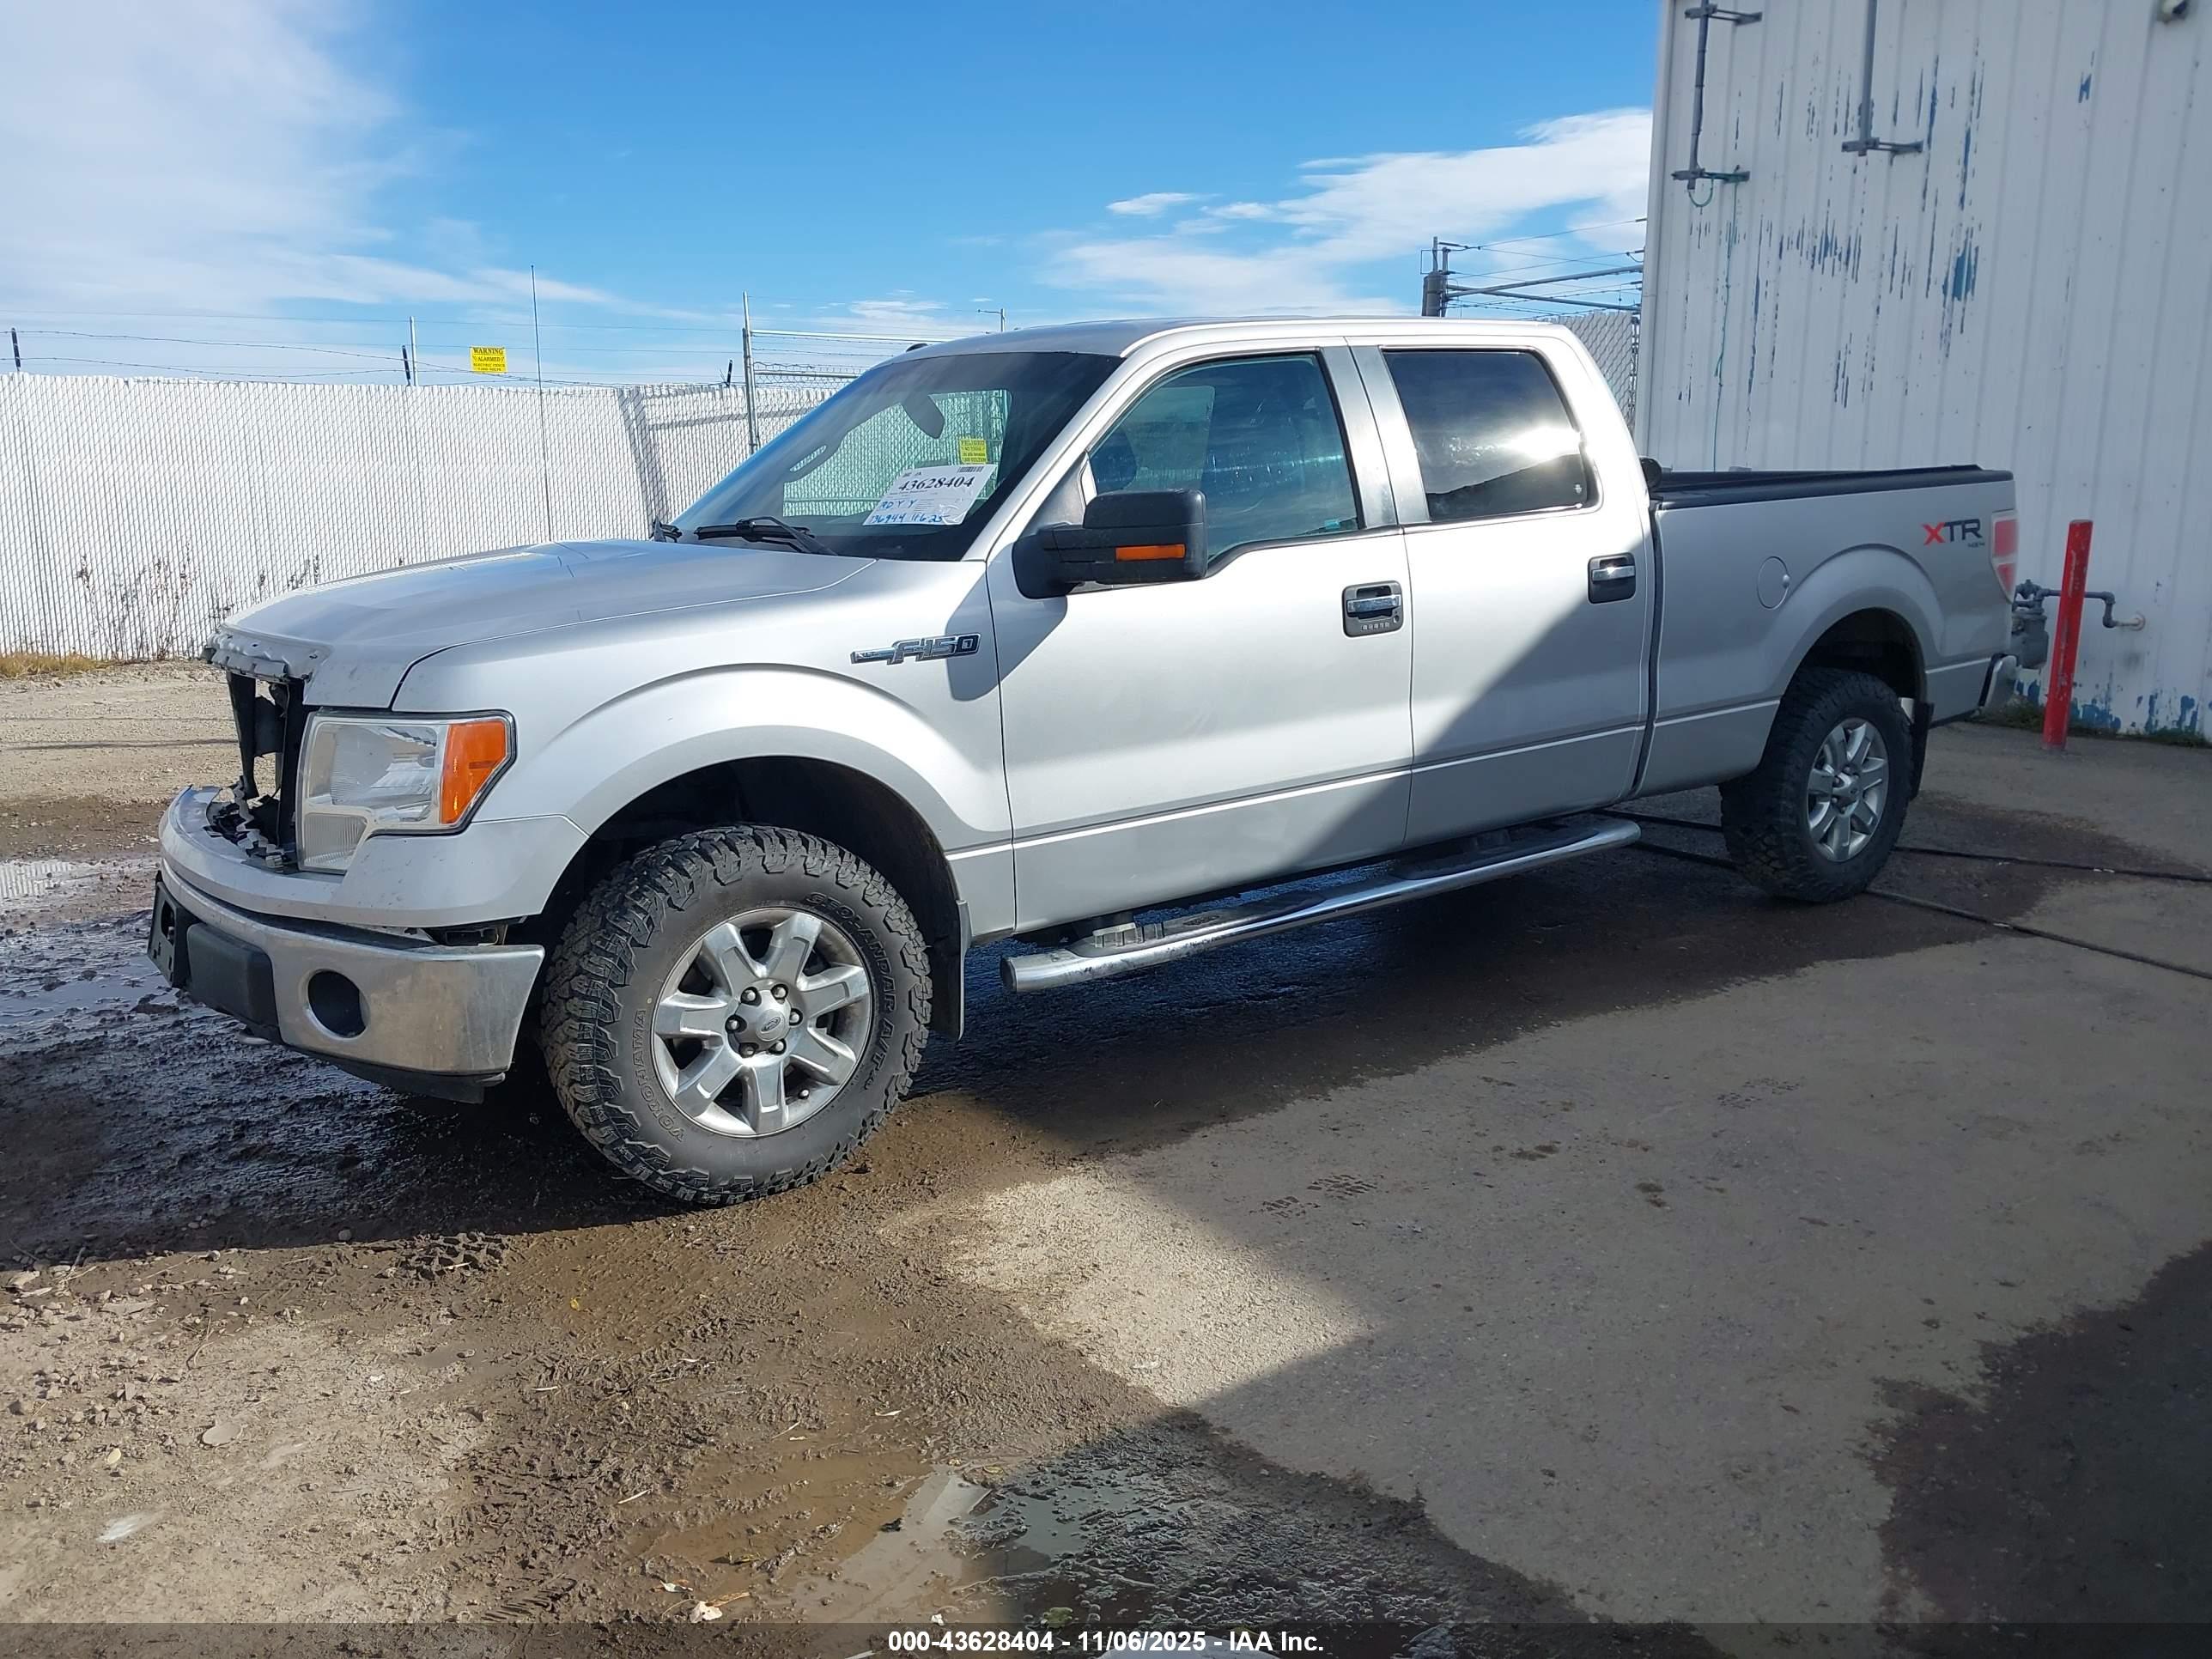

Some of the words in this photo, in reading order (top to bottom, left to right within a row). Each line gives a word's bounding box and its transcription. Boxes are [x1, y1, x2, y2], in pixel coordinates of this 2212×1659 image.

[898, 476, 975, 490] 43628404
[1923, 519, 1983, 545] XTR
[632, 1010, 685, 1143] YOKOHAMA
